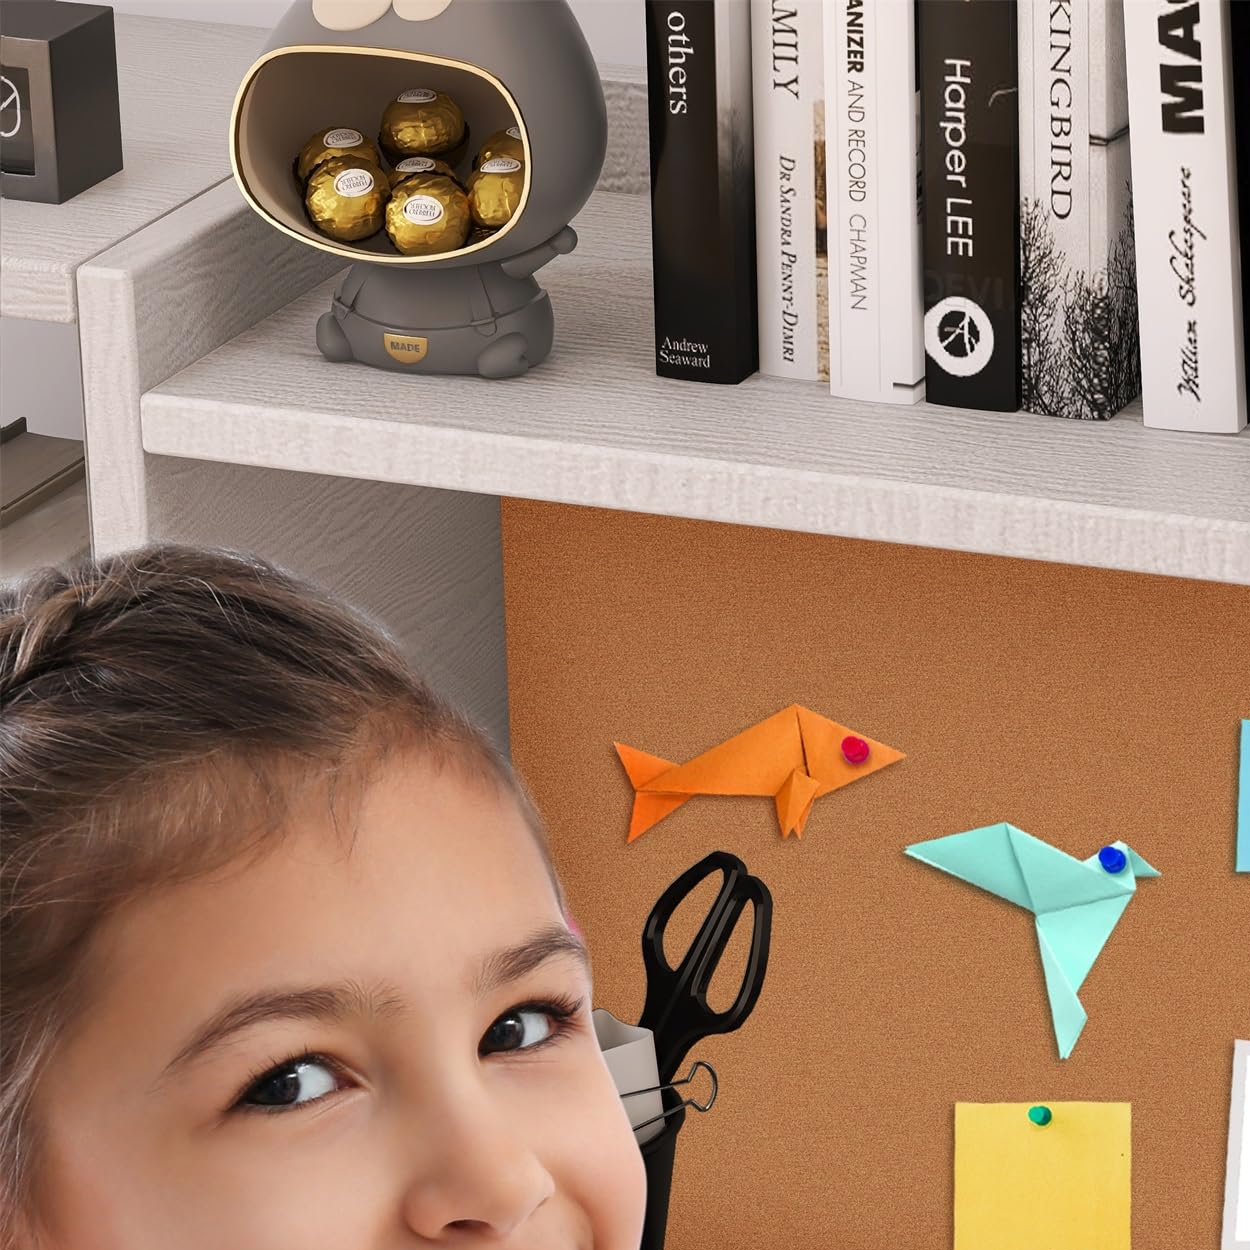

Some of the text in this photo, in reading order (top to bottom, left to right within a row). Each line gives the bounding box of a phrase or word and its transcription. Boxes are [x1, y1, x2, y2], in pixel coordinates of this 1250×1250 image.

[667, 11, 694, 114] others
[771, 0, 799, 99] MILY
[1158, 0, 1205, 134] MA
[847, 79, 865, 123] AND
[1050, 0, 1073, 220] KINGBIRD
[848, 128, 867, 202] RECORD
[939, 58, 973, 257] Harper LEE
[849, 214, 868, 311] CHAPMAN
[659, 350, 711, 368] Seaward
[662, 336, 709, 354] Andrew
